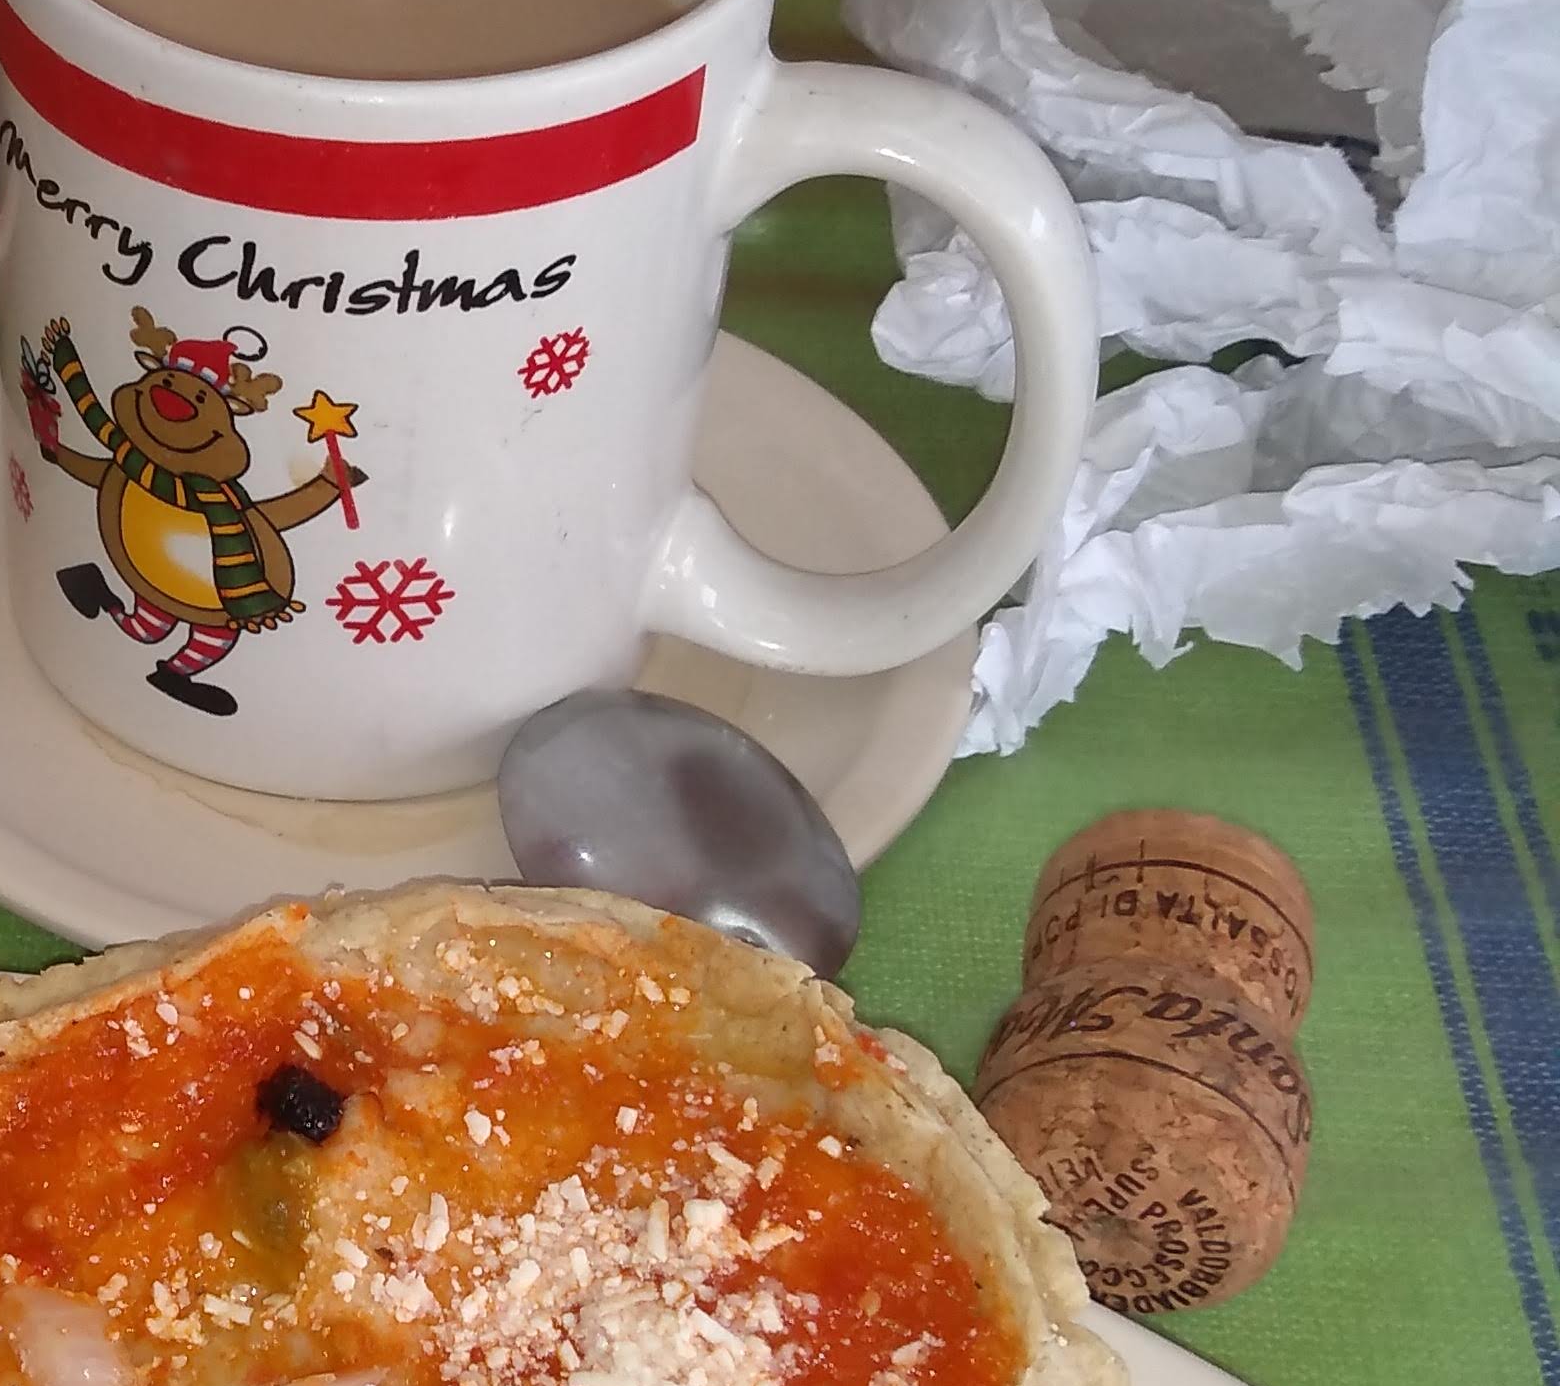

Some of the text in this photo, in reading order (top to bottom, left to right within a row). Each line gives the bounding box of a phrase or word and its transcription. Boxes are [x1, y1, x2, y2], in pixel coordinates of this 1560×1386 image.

[0, 120, 578, 315] Merry Christmas
[1089, 1188, 1232, 1313] VALDOBBIADE
